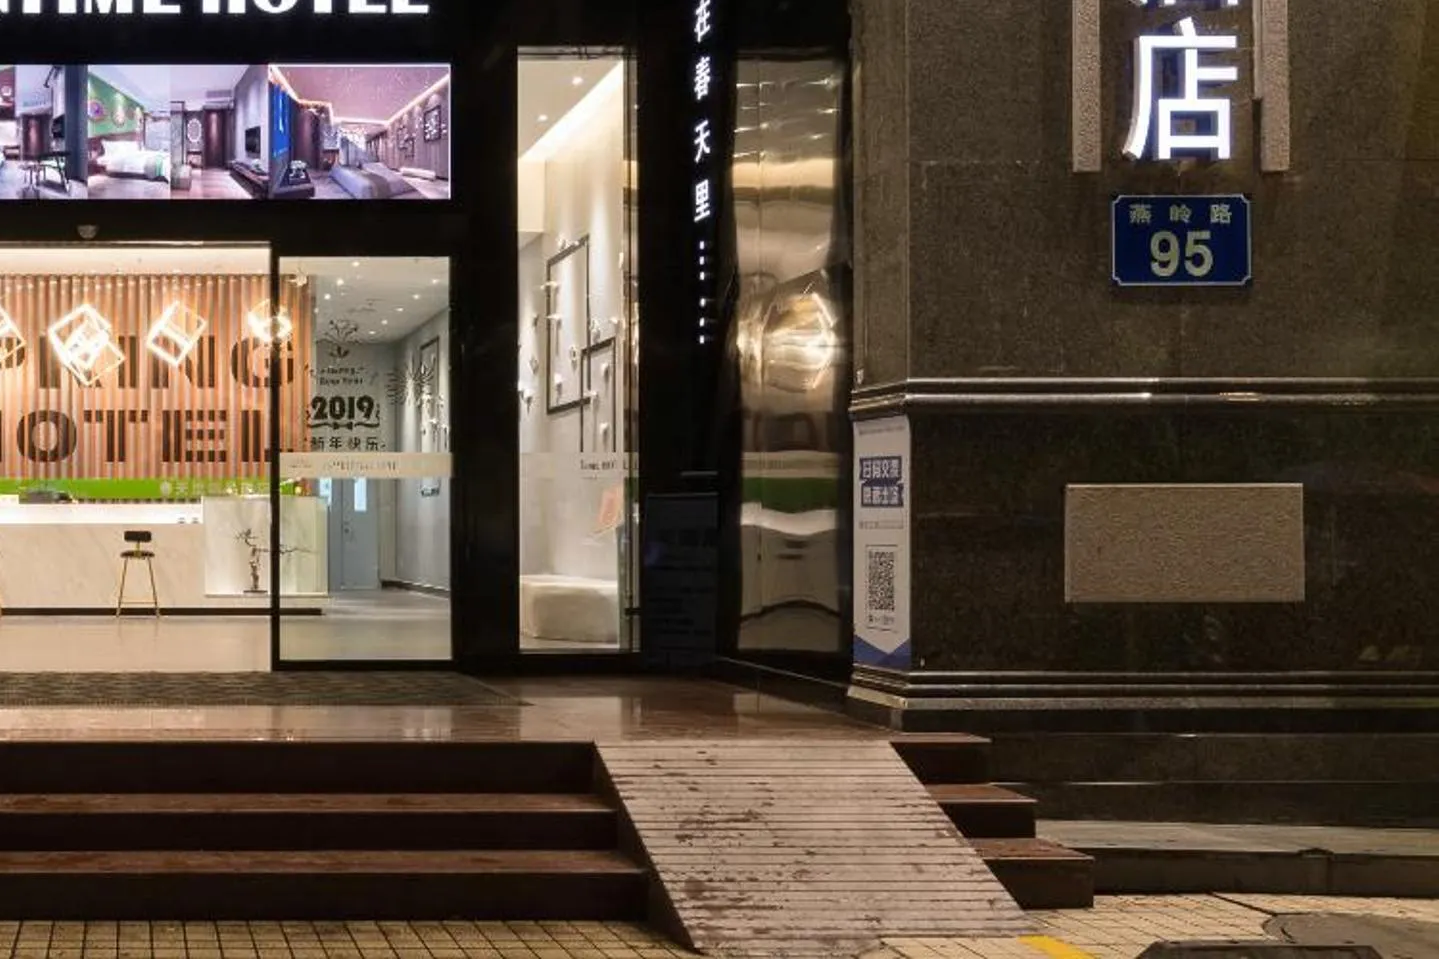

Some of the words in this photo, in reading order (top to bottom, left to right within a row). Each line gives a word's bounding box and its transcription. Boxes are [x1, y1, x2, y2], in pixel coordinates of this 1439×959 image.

[1128, 203, 1232, 224] 燕岭路
[1150, 230, 1214, 277] 95
[311, 394, 375, 420] 2019
